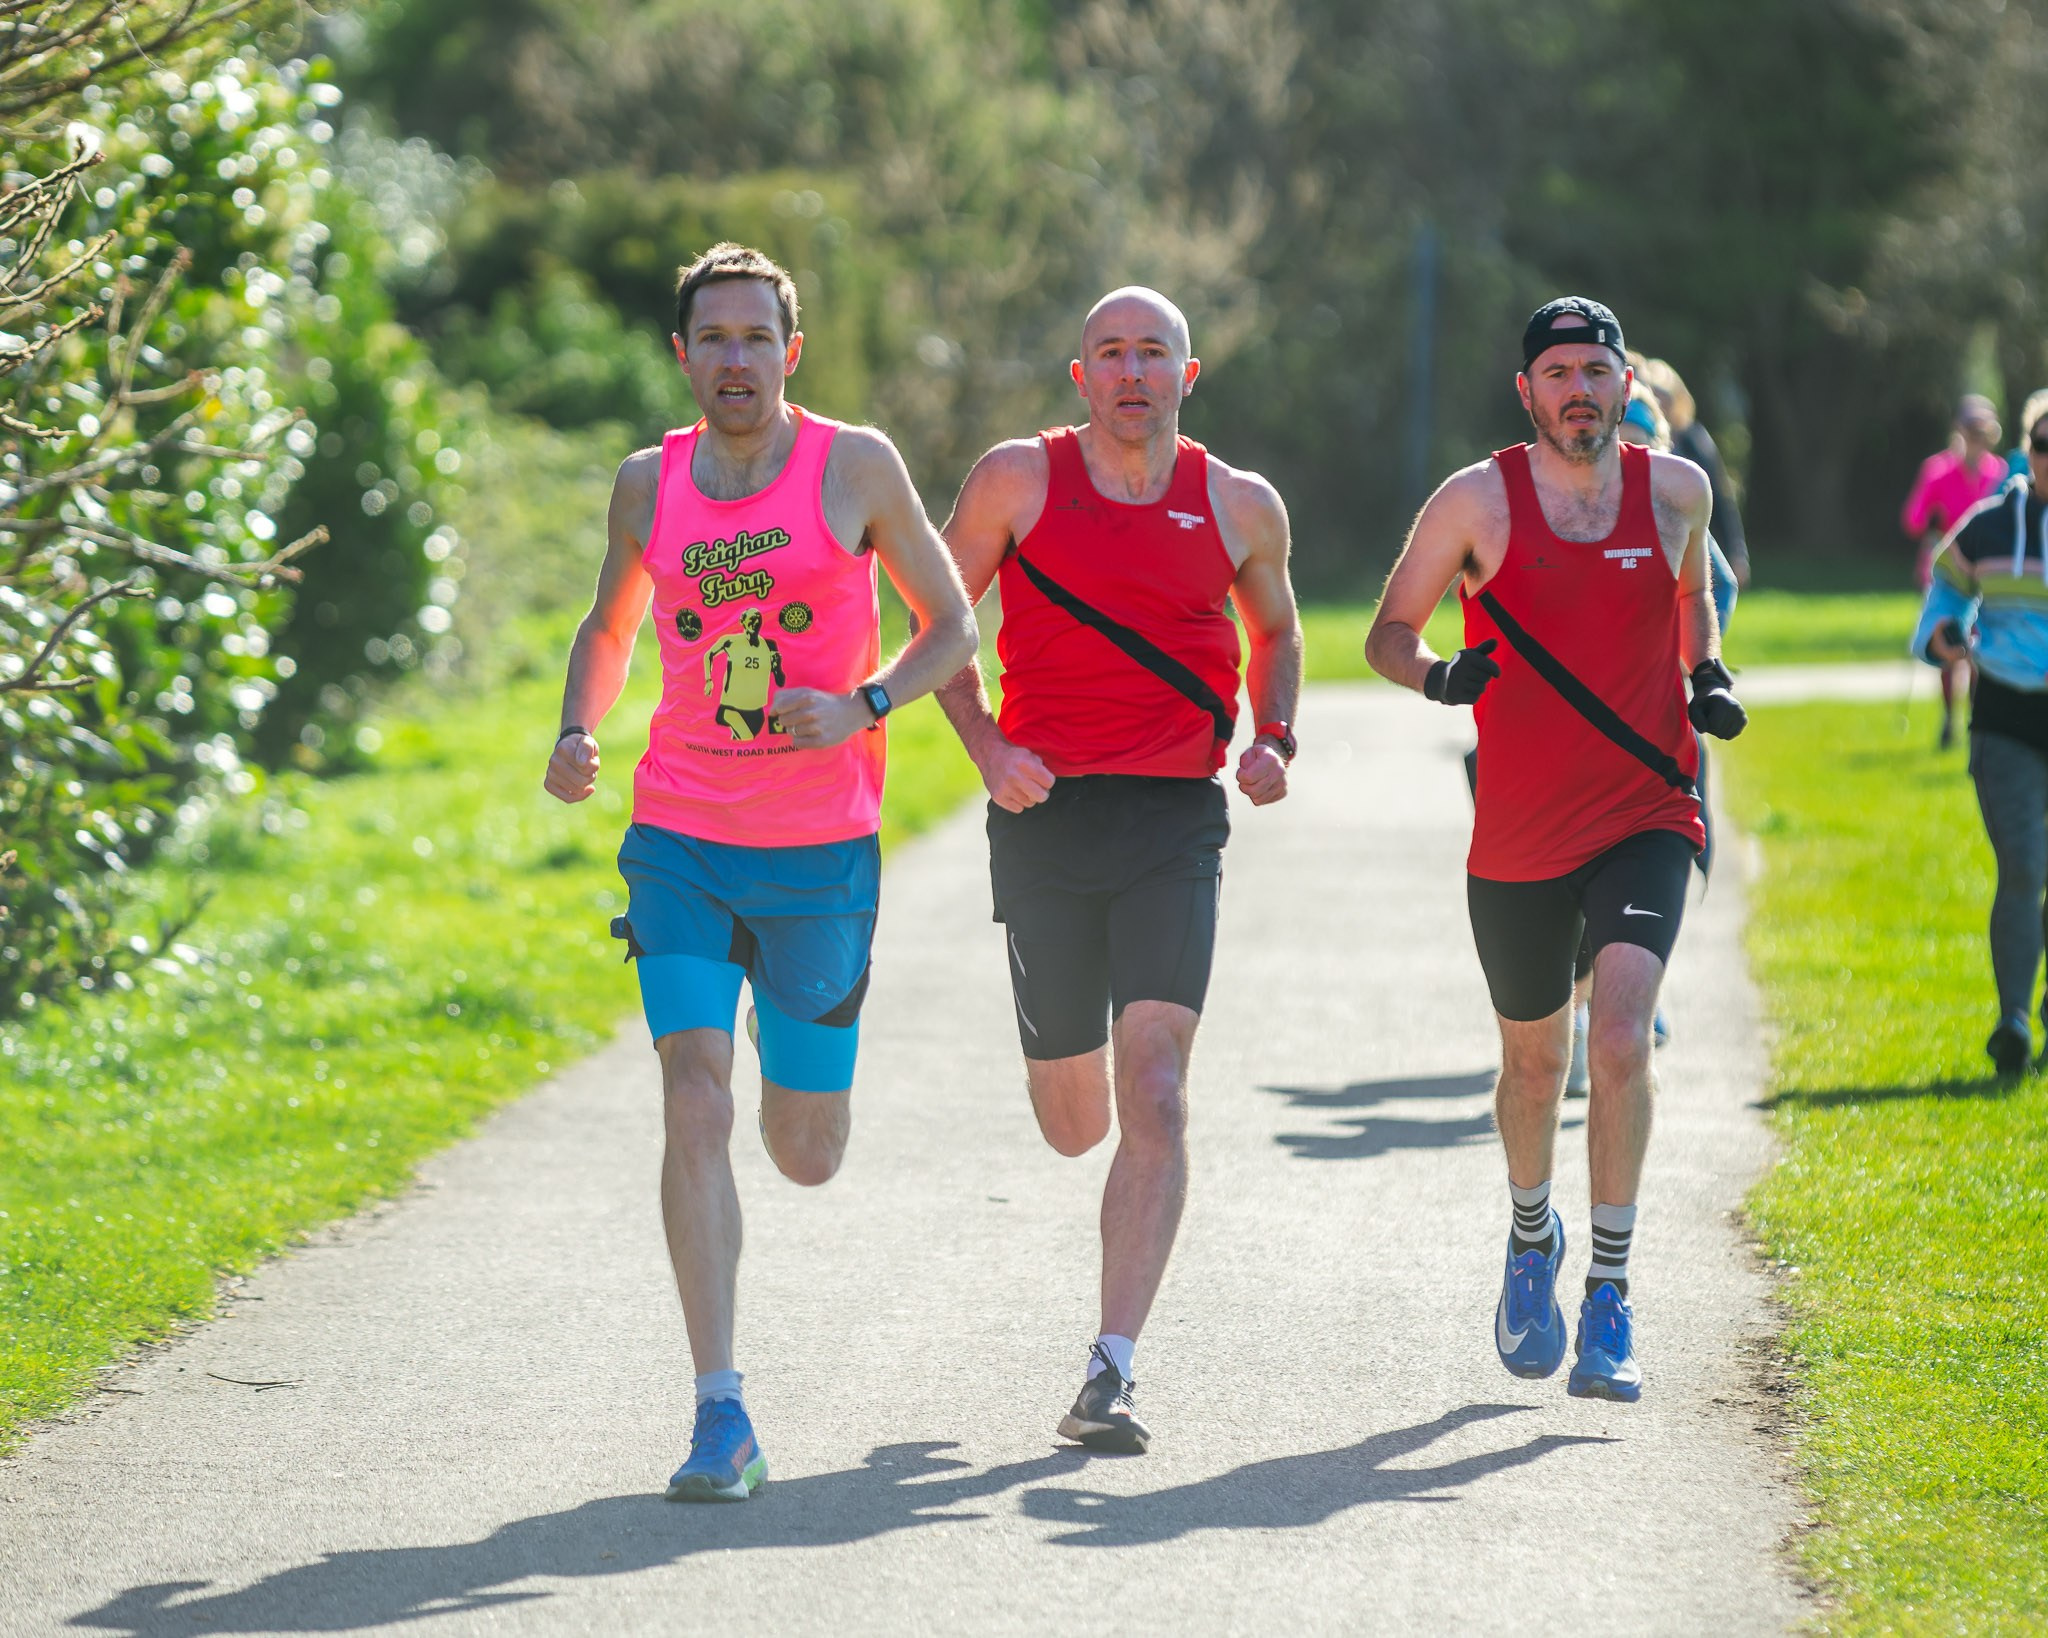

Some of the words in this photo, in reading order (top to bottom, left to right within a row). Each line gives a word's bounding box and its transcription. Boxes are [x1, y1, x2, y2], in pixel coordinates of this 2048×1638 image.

[1180, 520, 1193, 529] AC
[682, 527, 791, 577] Feighan
[1603, 547, 1653, 558] WIMBORNE
[1621, 558, 1637, 569] AC
[699, 568, 775, 608] Fury
[745, 656, 760, 670] 25
[685, 743, 710, 754] SOUTH
[711, 748, 733, 757] WEST
[737, 748, 764, 757] ROAD
[767, 745, 799, 755] RUNN
